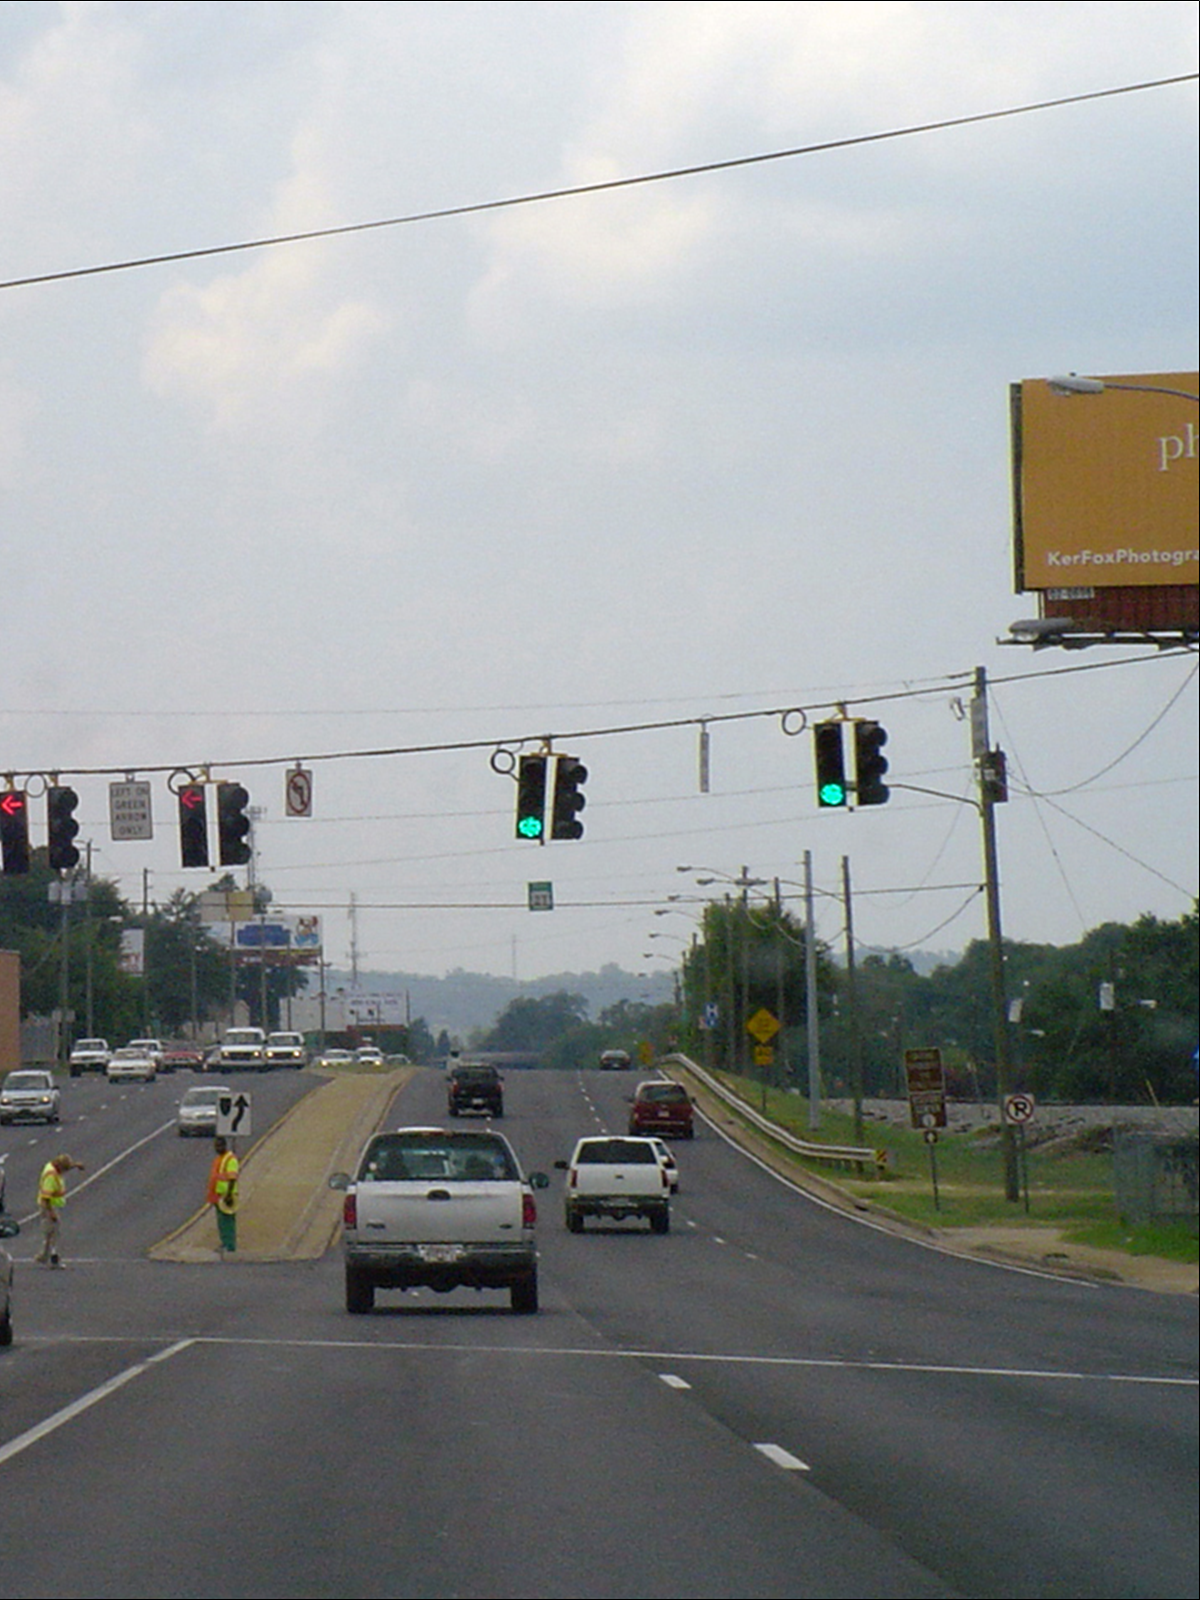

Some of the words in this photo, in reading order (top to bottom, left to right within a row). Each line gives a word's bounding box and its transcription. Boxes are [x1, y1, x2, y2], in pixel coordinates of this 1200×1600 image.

[114, 799, 146, 810] GREEN
[115, 811, 148, 822] ARROW
[119, 824, 143, 836] ONLY
